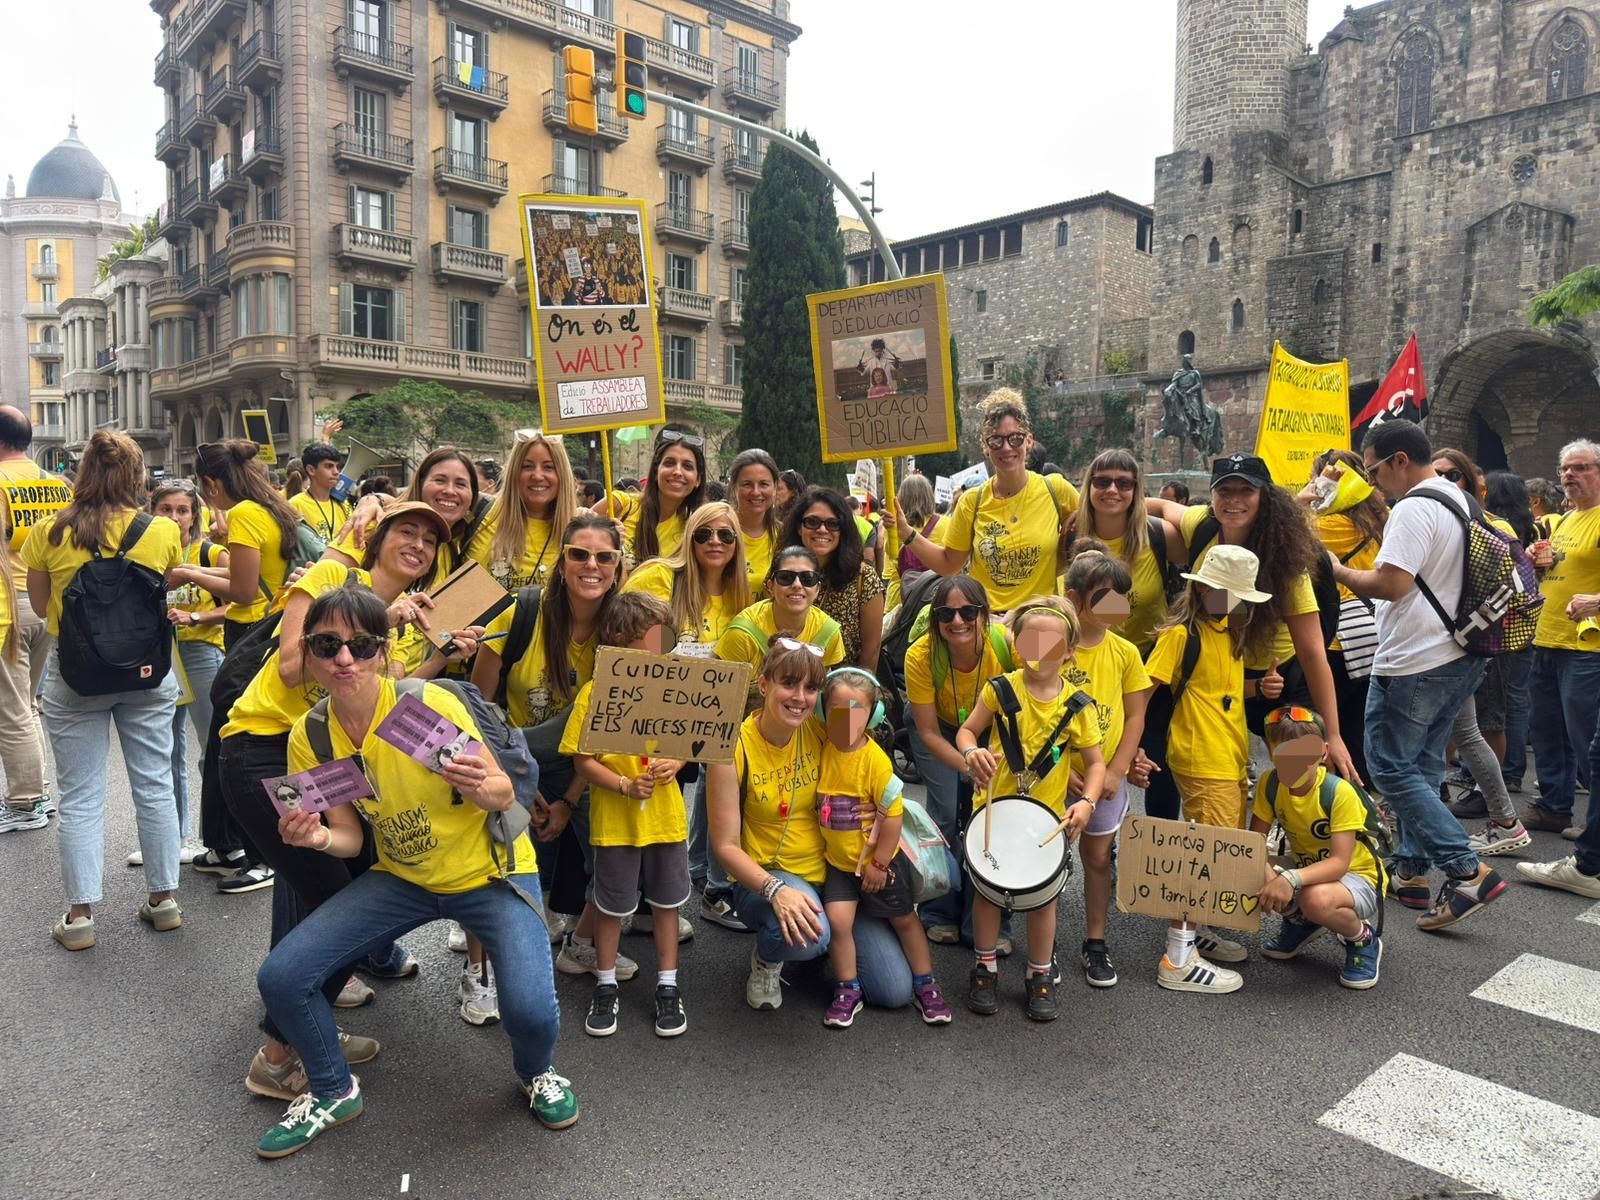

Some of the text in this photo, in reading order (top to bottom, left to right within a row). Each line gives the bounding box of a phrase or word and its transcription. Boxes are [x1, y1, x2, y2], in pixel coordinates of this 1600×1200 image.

[818, 286, 924, 318] DEPARTAMENT
[548, 313, 584, 343] On
[618, 308, 641, 333] el
[832, 303, 923, 335] D'EDUCACIÓ
[556, 334, 644, 374] WALLY?
[591, 378, 643, 394] ASSAMBLEA
[562, 392, 648, 416] de TREBALLADORES
[843, 391, 929, 421] EDUCACIÓ
[850, 415, 929, 447] PÚBLICA
[611, 657, 734, 689] CUIDEU QUI
[608, 686, 724, 717] ENS EDUCA,
[590, 715, 622, 733] ELS
[1129, 819, 1143, 840] Si
